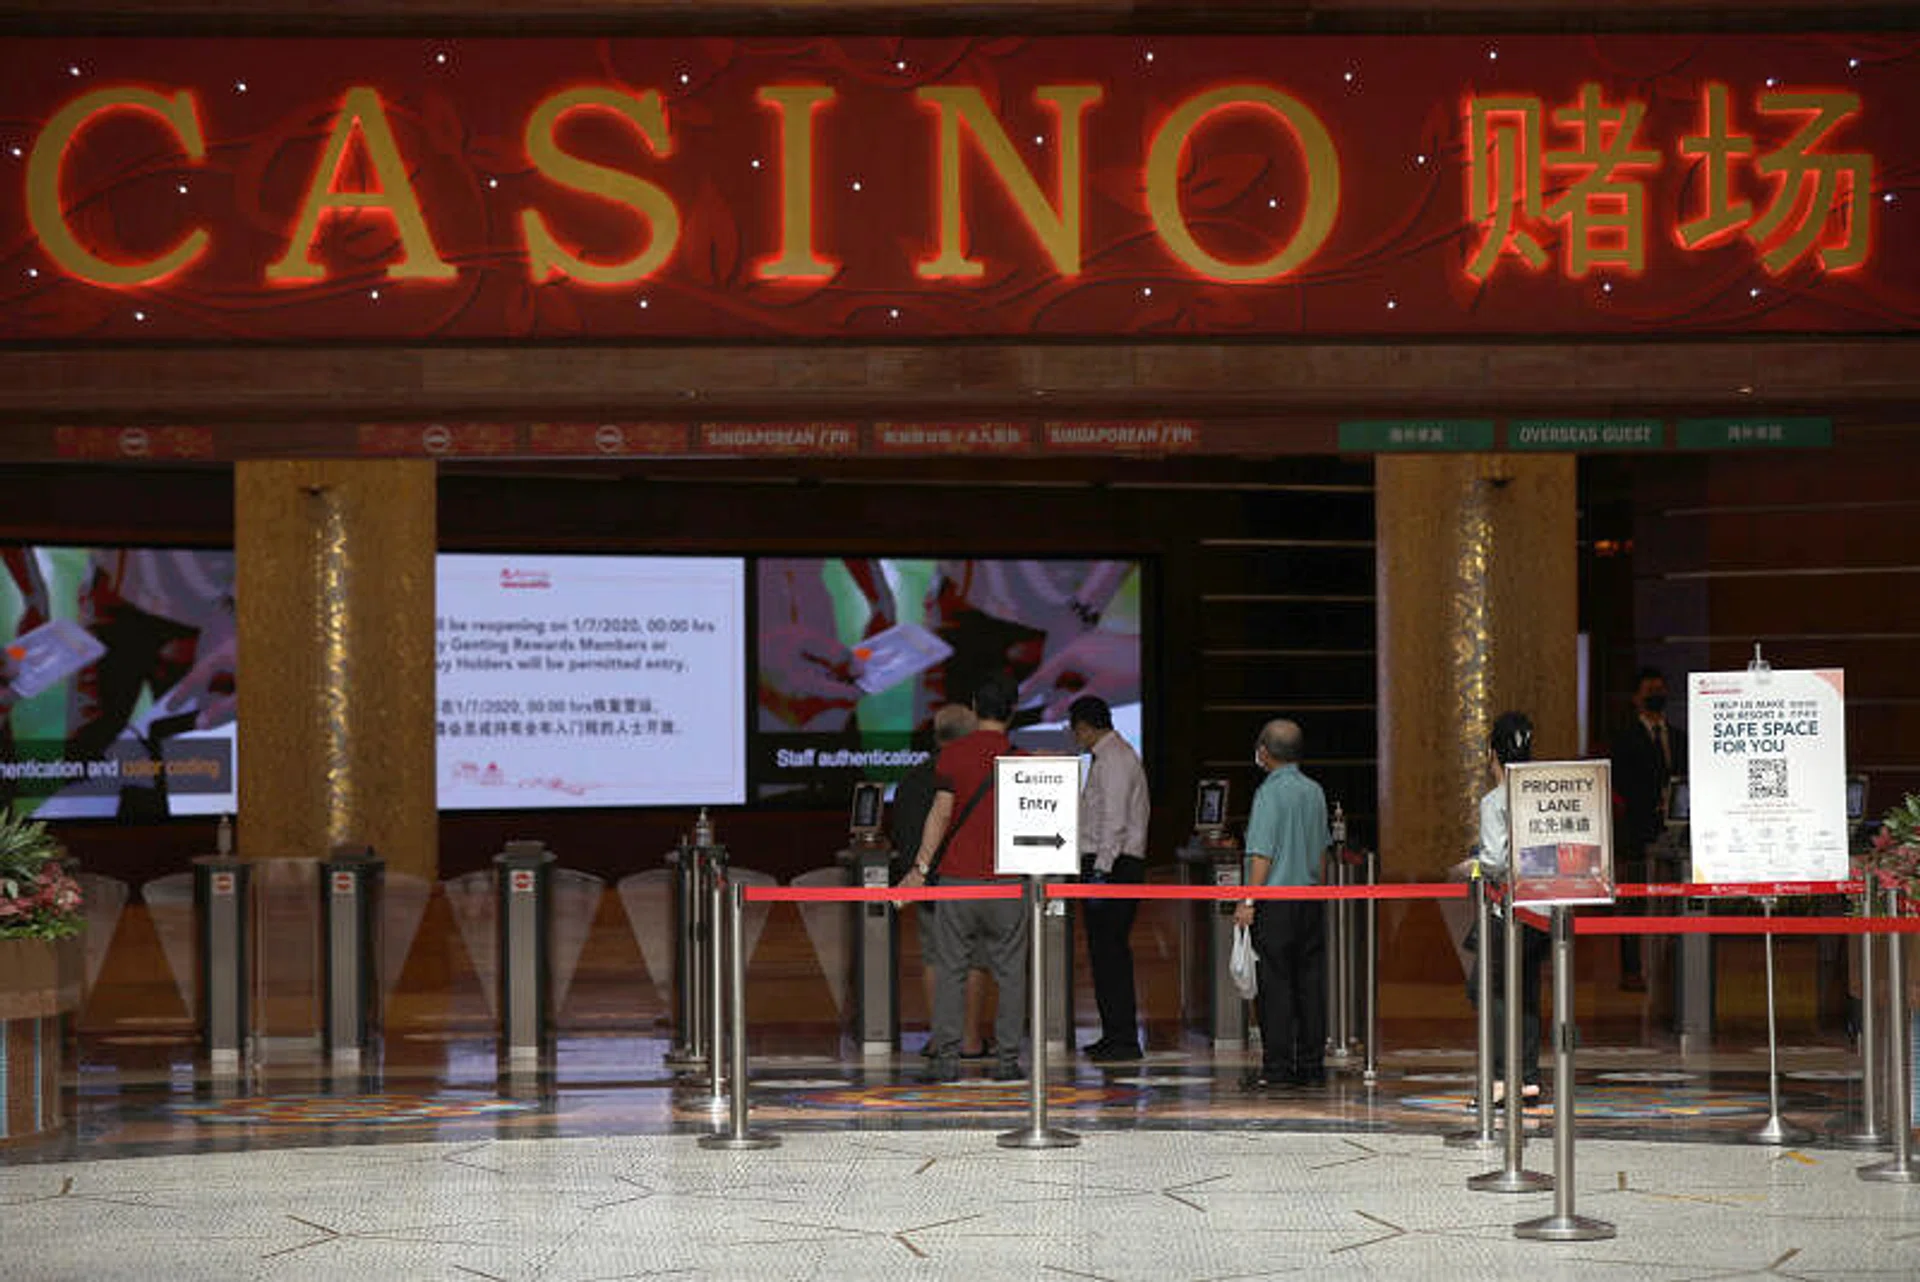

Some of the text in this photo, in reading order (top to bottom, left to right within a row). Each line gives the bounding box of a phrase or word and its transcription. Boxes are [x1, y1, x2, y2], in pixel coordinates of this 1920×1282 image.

[25, 84, 1343, 287] CASINO
[1463, 82, 1876, 281] 赌场
[1519, 425, 1652, 443] OVERSEAS GUEST
[471, 617, 546, 636] reopening
[450, 636, 508, 655] Genting
[514, 636, 574, 652] Rewards
[579, 636, 648, 652] Members
[456, 656, 513, 672] Holders
[568, 656, 642, 673] permitted
[1755, 700, 1785, 709] MAKE
[1713, 720, 1819, 738] SAFE SPACE
[1713, 739, 1785, 754] FOR YOU
[776, 748, 815, 767] Staff
[86, 757, 119, 778] and
[1014, 770, 1064, 785] Casino
[1521, 778, 1595, 793] PRIORITY
[1018, 796, 1058, 813] Entry
[1537, 799, 1582, 813] LANE
